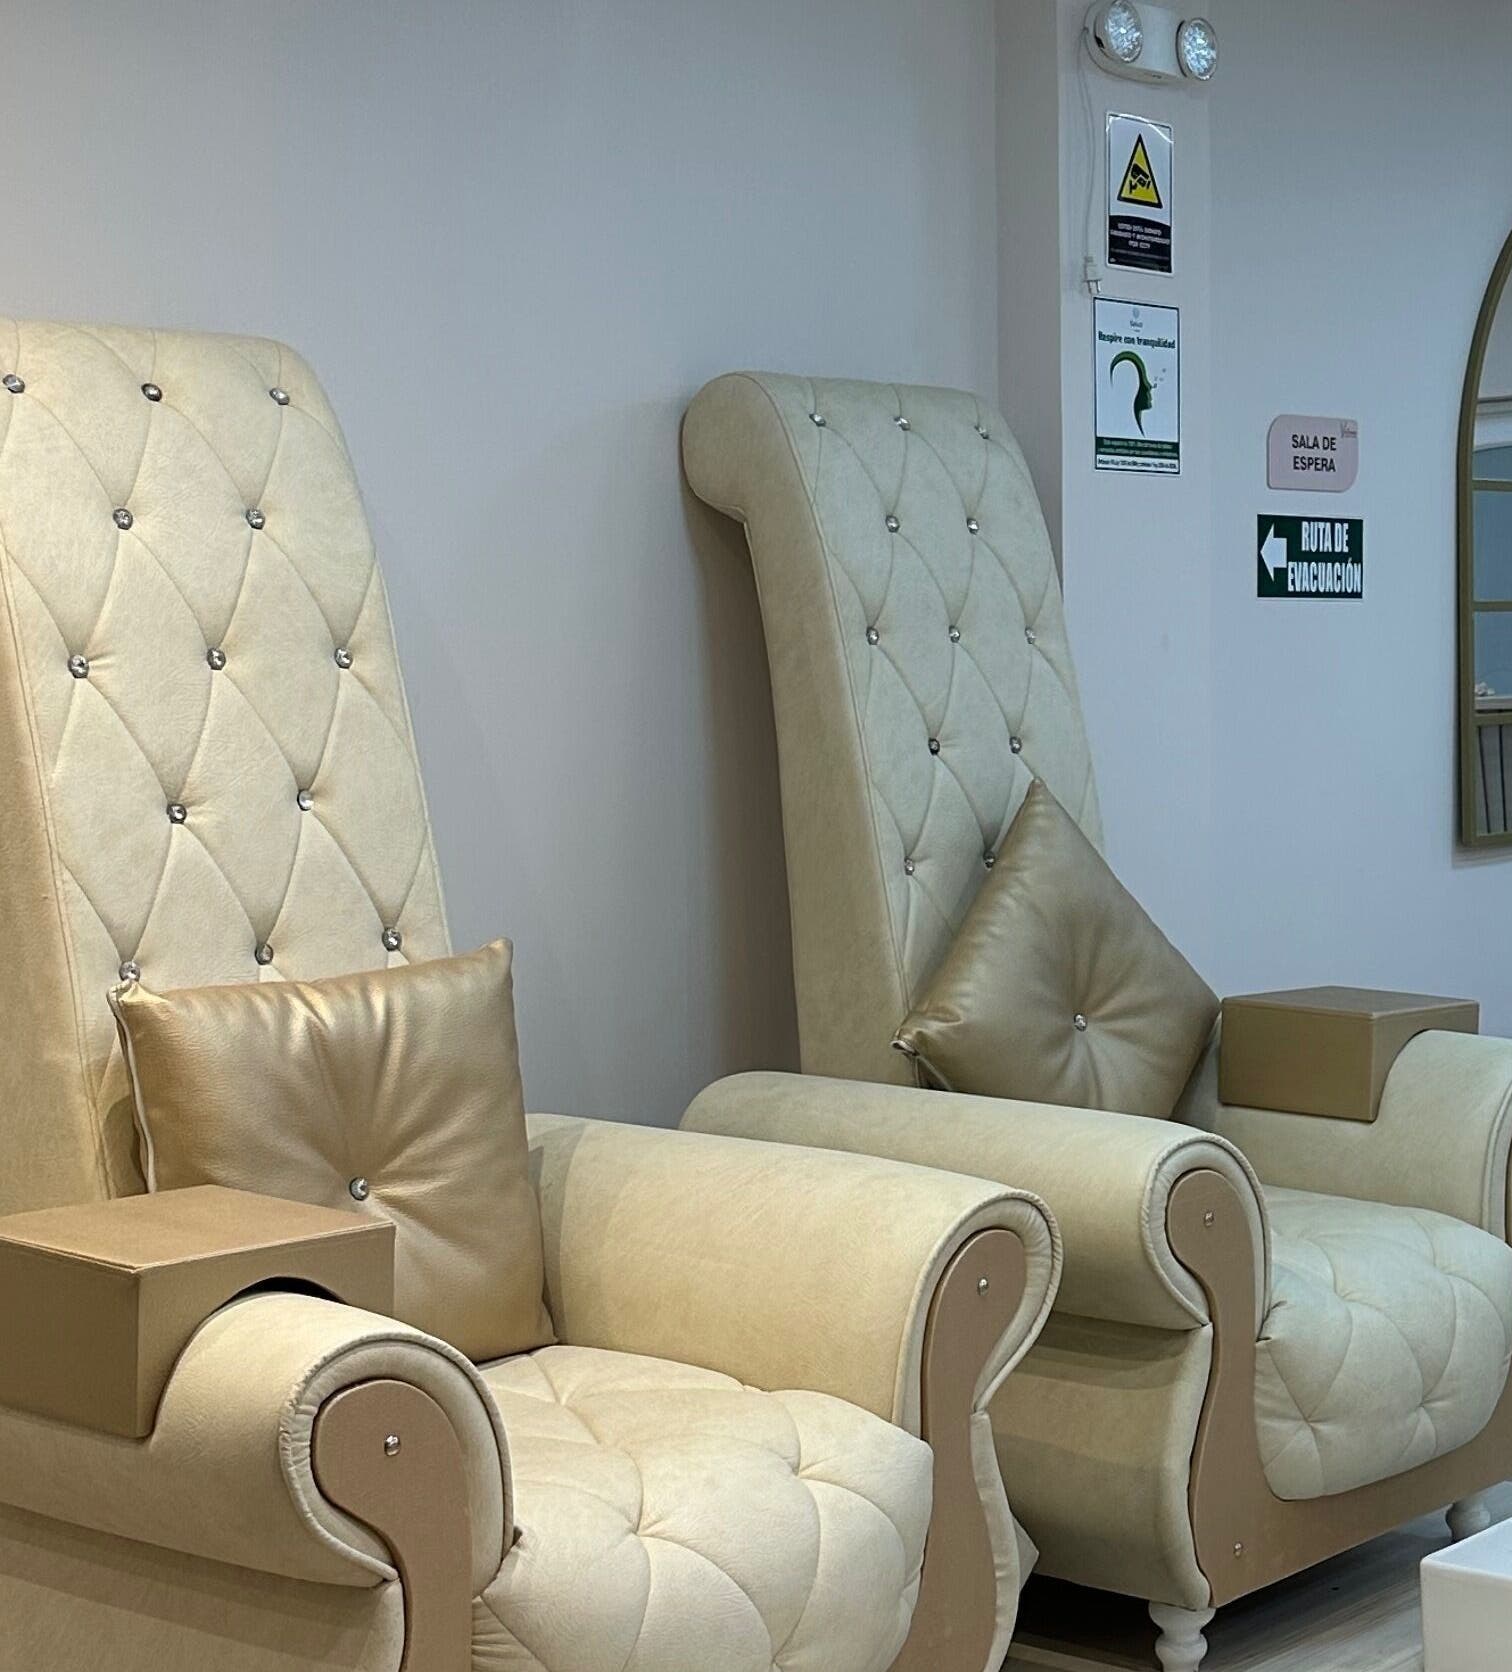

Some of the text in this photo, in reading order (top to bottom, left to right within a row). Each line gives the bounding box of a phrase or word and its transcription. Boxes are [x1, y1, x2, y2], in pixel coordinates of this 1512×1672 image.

[1291, 434, 1337, 451] SALA DE
[1293, 455, 1336, 472] ESPERA
[1301, 521, 1349, 553] RUTA DE
[1287, 557, 1361, 593] EVACUACIÓN
